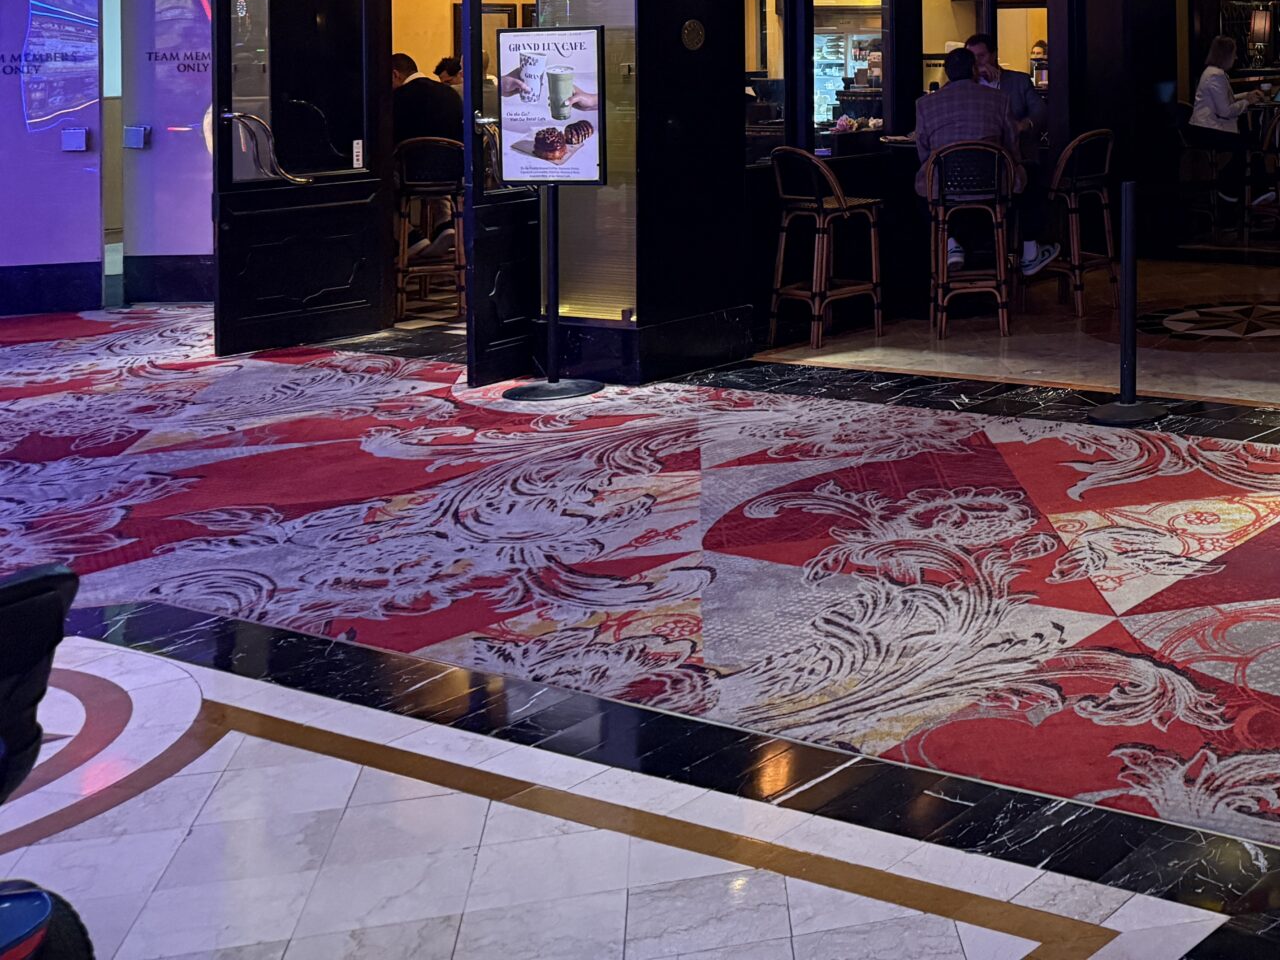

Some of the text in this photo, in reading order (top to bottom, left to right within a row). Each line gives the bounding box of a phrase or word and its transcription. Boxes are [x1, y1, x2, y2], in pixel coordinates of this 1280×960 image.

[508, 43, 540, 52] GRAND
[561, 41, 587, 51] CAFE
[145, 51, 181, 61] TEAM
[2, 65, 41, 75] ONLY
[177, 63, 210, 73] ONLY
